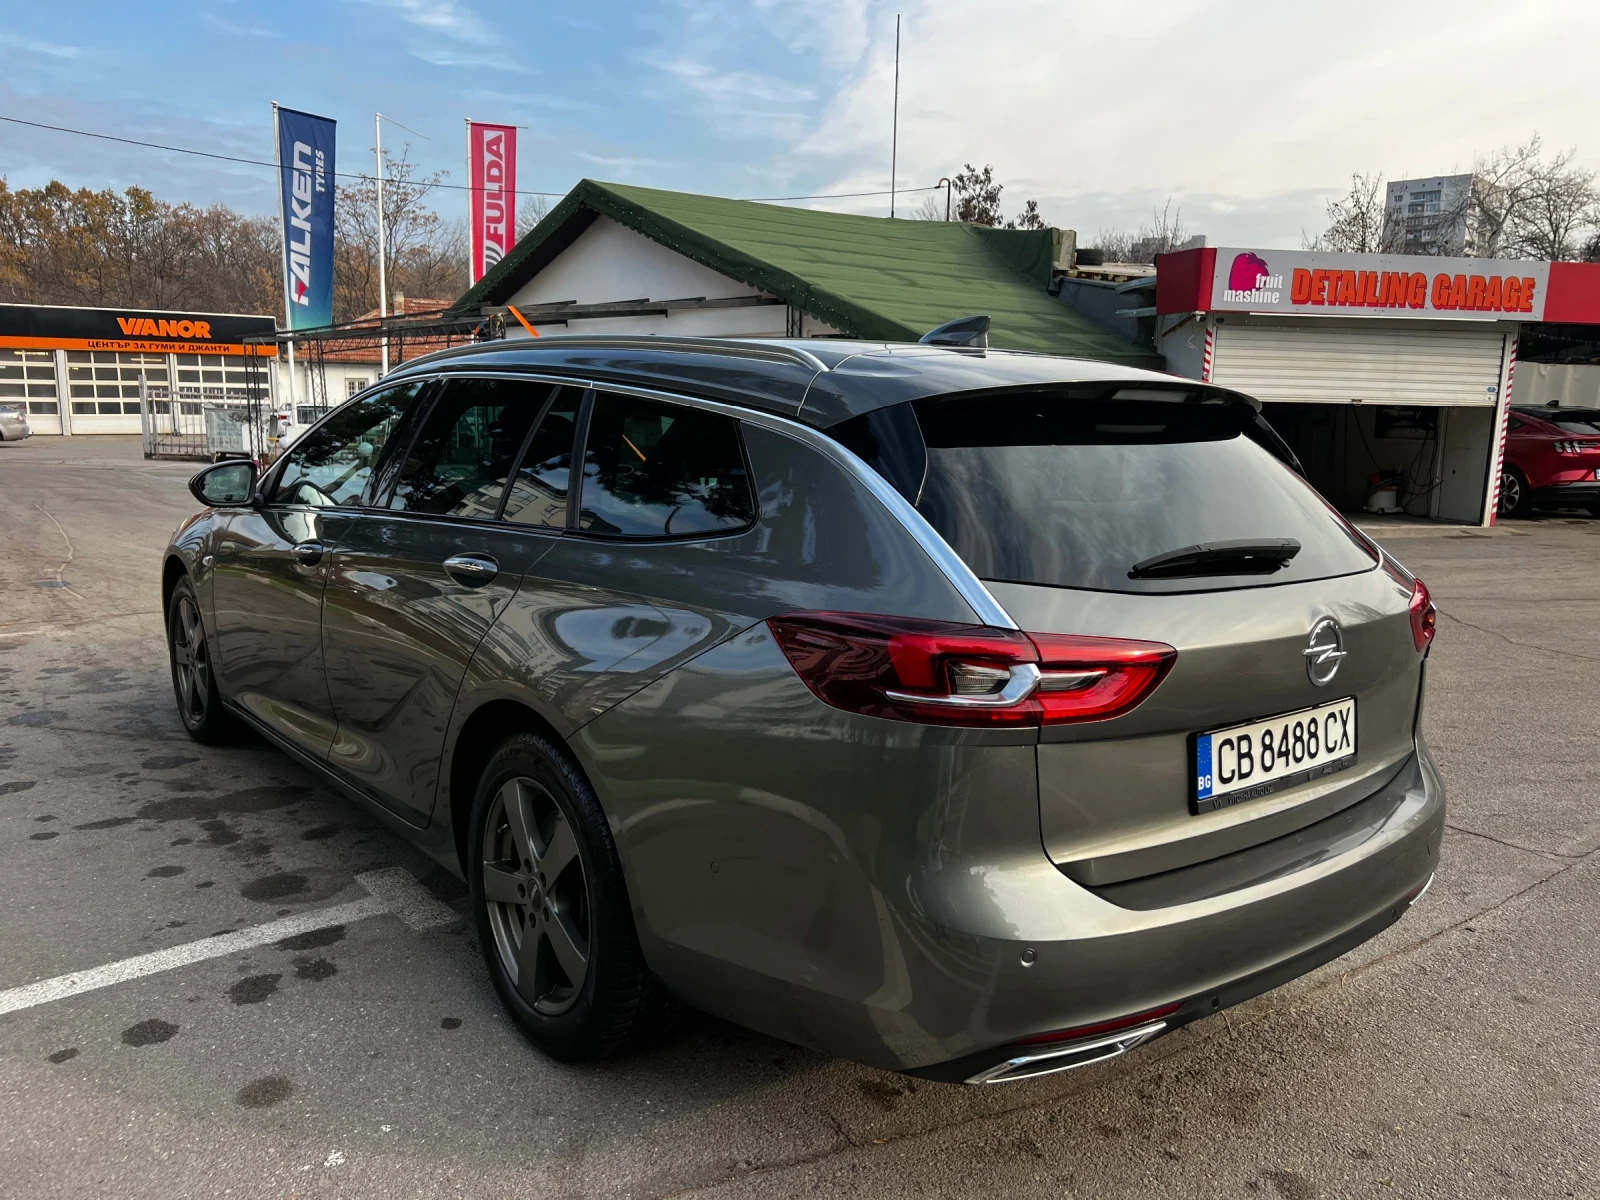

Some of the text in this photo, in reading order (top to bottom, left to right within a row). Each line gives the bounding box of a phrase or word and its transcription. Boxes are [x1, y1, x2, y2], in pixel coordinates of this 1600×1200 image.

[315, 149, 325, 193] TYRES
[485, 133, 505, 251] FULDA
[289, 140, 312, 307] FALKEN
[1223, 289, 1280, 304] mashine
[1255, 273, 1283, 289] fruit
[1290, 268, 1536, 313] DETAILING GARAGE
[116, 317, 212, 338] VIANOR
[87, 340, 130, 349] ЦЕНТЪР
[134, 341, 146, 350] ЗА
[149, 342, 176, 351] ГУМИ
[188, 344, 230, 353] ДЖАНТИ
[1218, 733, 1254, 785] CB
[1260, 717, 1319, 773] 8488
[1324, 706, 1351, 754] CX
[1198, 774, 1212, 791] BG
